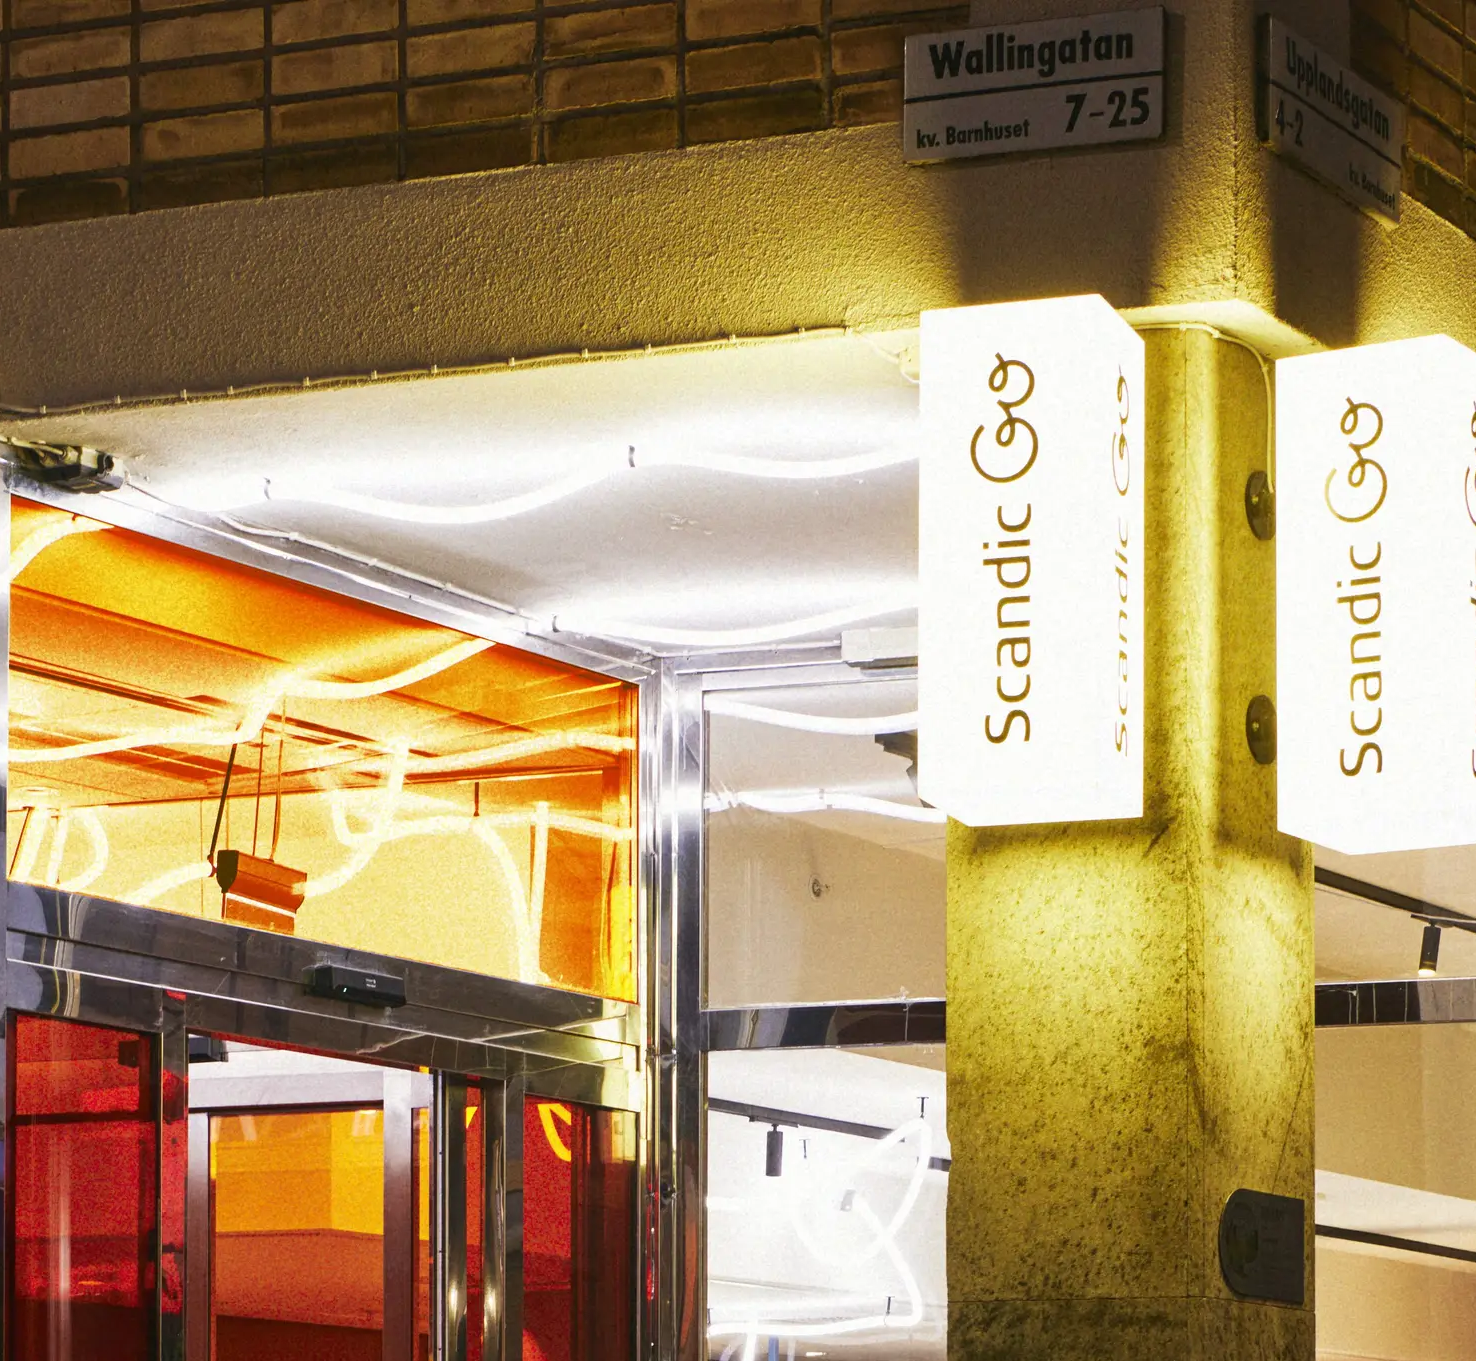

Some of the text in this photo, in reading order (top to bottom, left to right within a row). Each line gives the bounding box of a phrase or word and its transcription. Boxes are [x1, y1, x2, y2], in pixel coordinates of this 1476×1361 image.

[929, 29, 1134, 79] Wallingatan
[1285, 35, 1390, 142] Upplandsgatan
[915, 118, 1031, 149] kv. Barnhuset
[1064, 86, 1151, 133] 7-25
[970, 352, 1039, 745] Scandic Go
[1110, 363, 1131, 758] Scandic Go
[1324, 396, 1388, 778] Scandic Go
